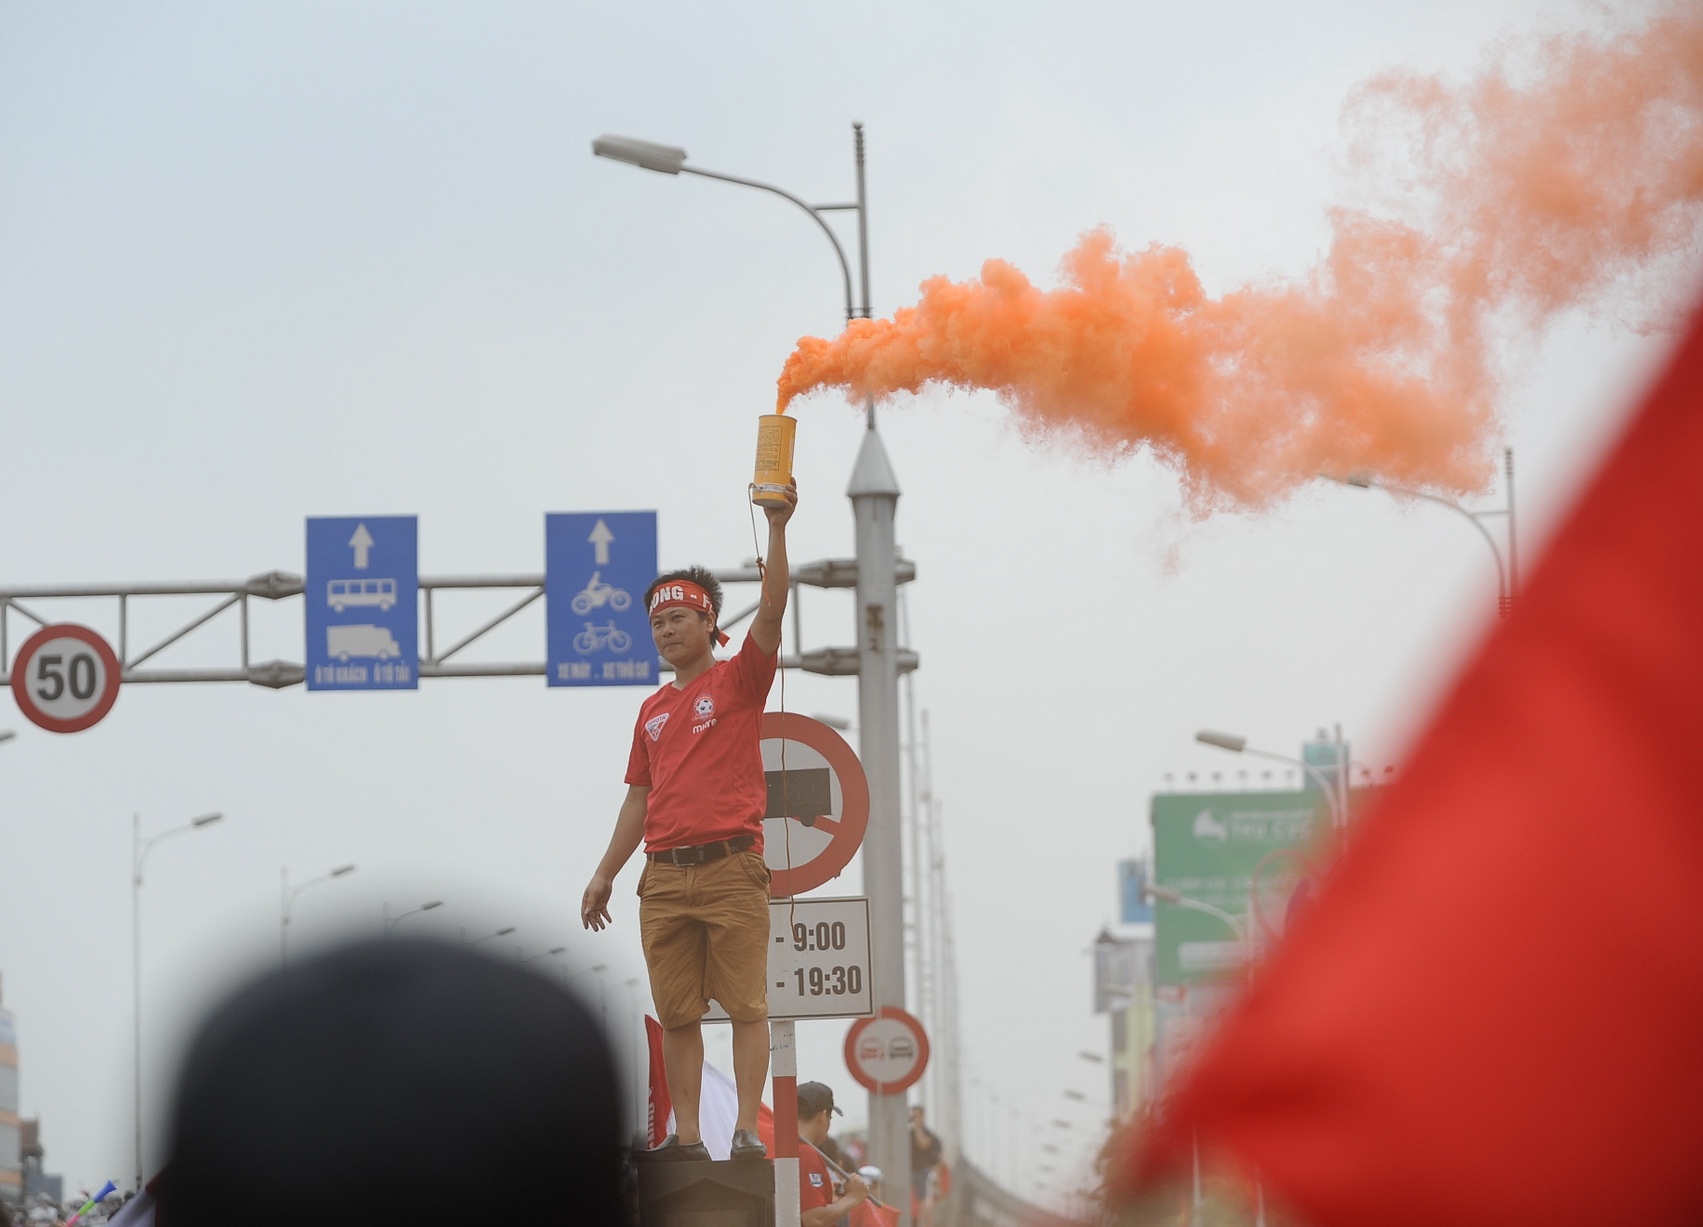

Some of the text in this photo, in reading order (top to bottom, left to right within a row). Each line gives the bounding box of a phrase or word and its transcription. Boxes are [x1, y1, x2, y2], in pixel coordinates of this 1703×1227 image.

[38, 653, 96, 701] 50
[794, 922, 846, 951] 9:00
[794, 966, 862, 996] 19:30
